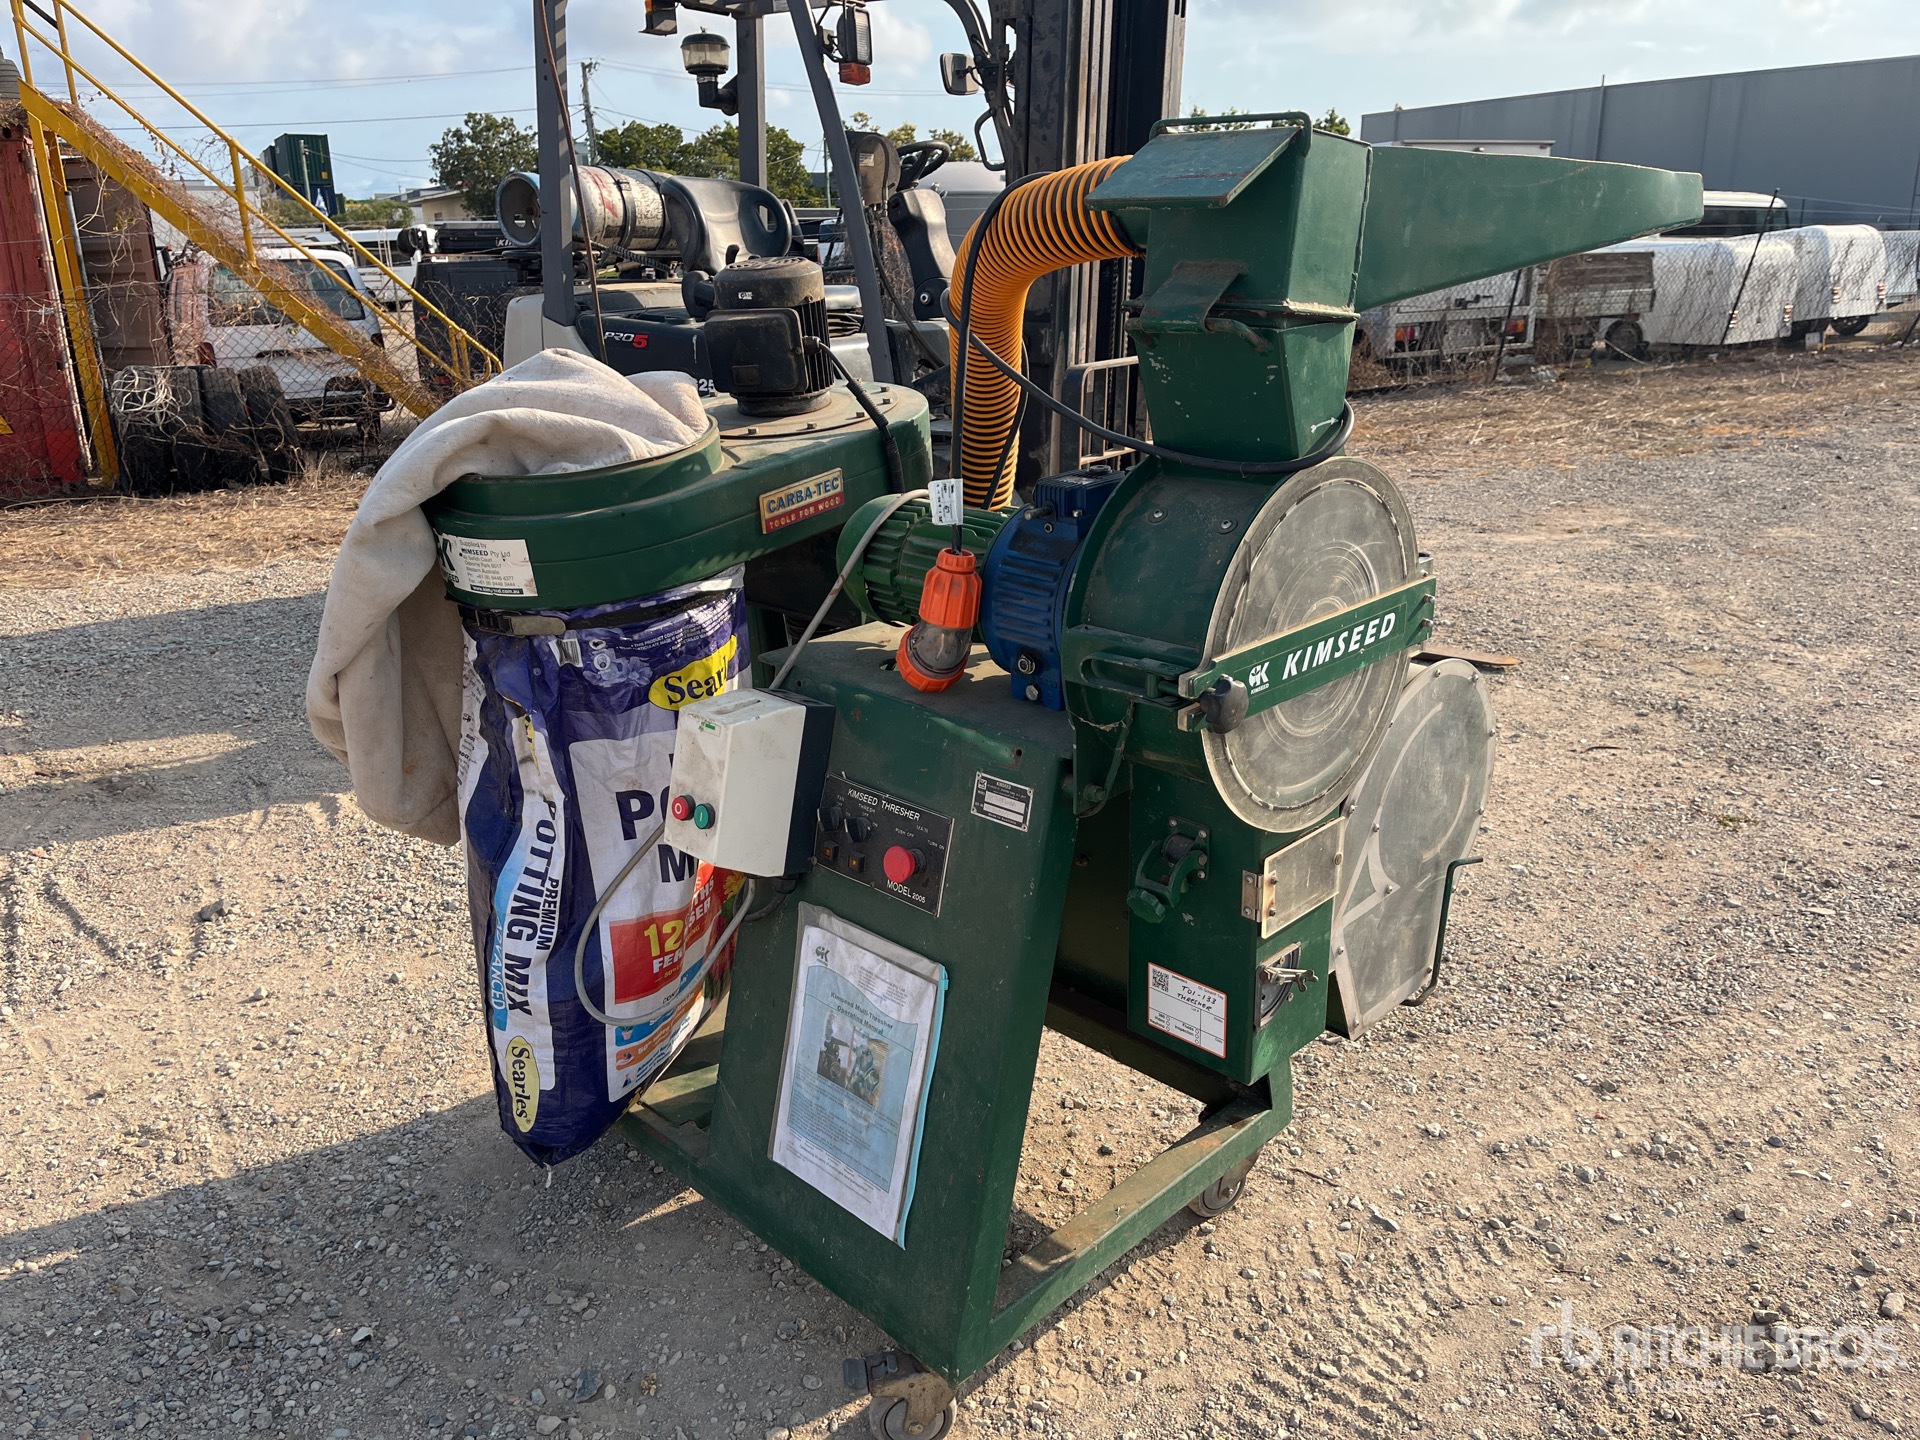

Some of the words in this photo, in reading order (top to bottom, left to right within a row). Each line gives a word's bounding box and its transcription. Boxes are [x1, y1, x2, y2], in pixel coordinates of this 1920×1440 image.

[767, 477, 840, 514] CARBA-TEC
[769, 513, 797, 530] TOOLS
[800, 507, 815, 518] FOR
[818, 497, 841, 511] WOOD
[460, 540, 480, 548] Supplied
[644, 636, 664, 646] PRODUCT
[1282, 612, 1396, 680] KIMSEED
[664, 655, 728, 705] Searl
[1250, 682, 1270, 694] KIMSEED
[848, 788, 878, 806] KIMSEED
[881, 800, 920, 821] THRESHER
[858, 804, 876, 813] THRESH
[895, 828, 906, 836] PUSH
[928, 840, 938, 848] TURN
[506, 795, 557, 942] POTTING
[886, 879, 912, 898] MODEL
[912, 892, 926, 903] 2005
[536, 876, 560, 950] PREMIUM
[504, 952, 532, 1016] MIX
[830, 992, 854, 1009] Kimseed
[855, 1004, 894, 1030] Multi-Thresher
[837, 1005, 863, 1024] Operating
[864, 1019, 884, 1036] Manual
[511, 1045, 532, 1121] Searles
